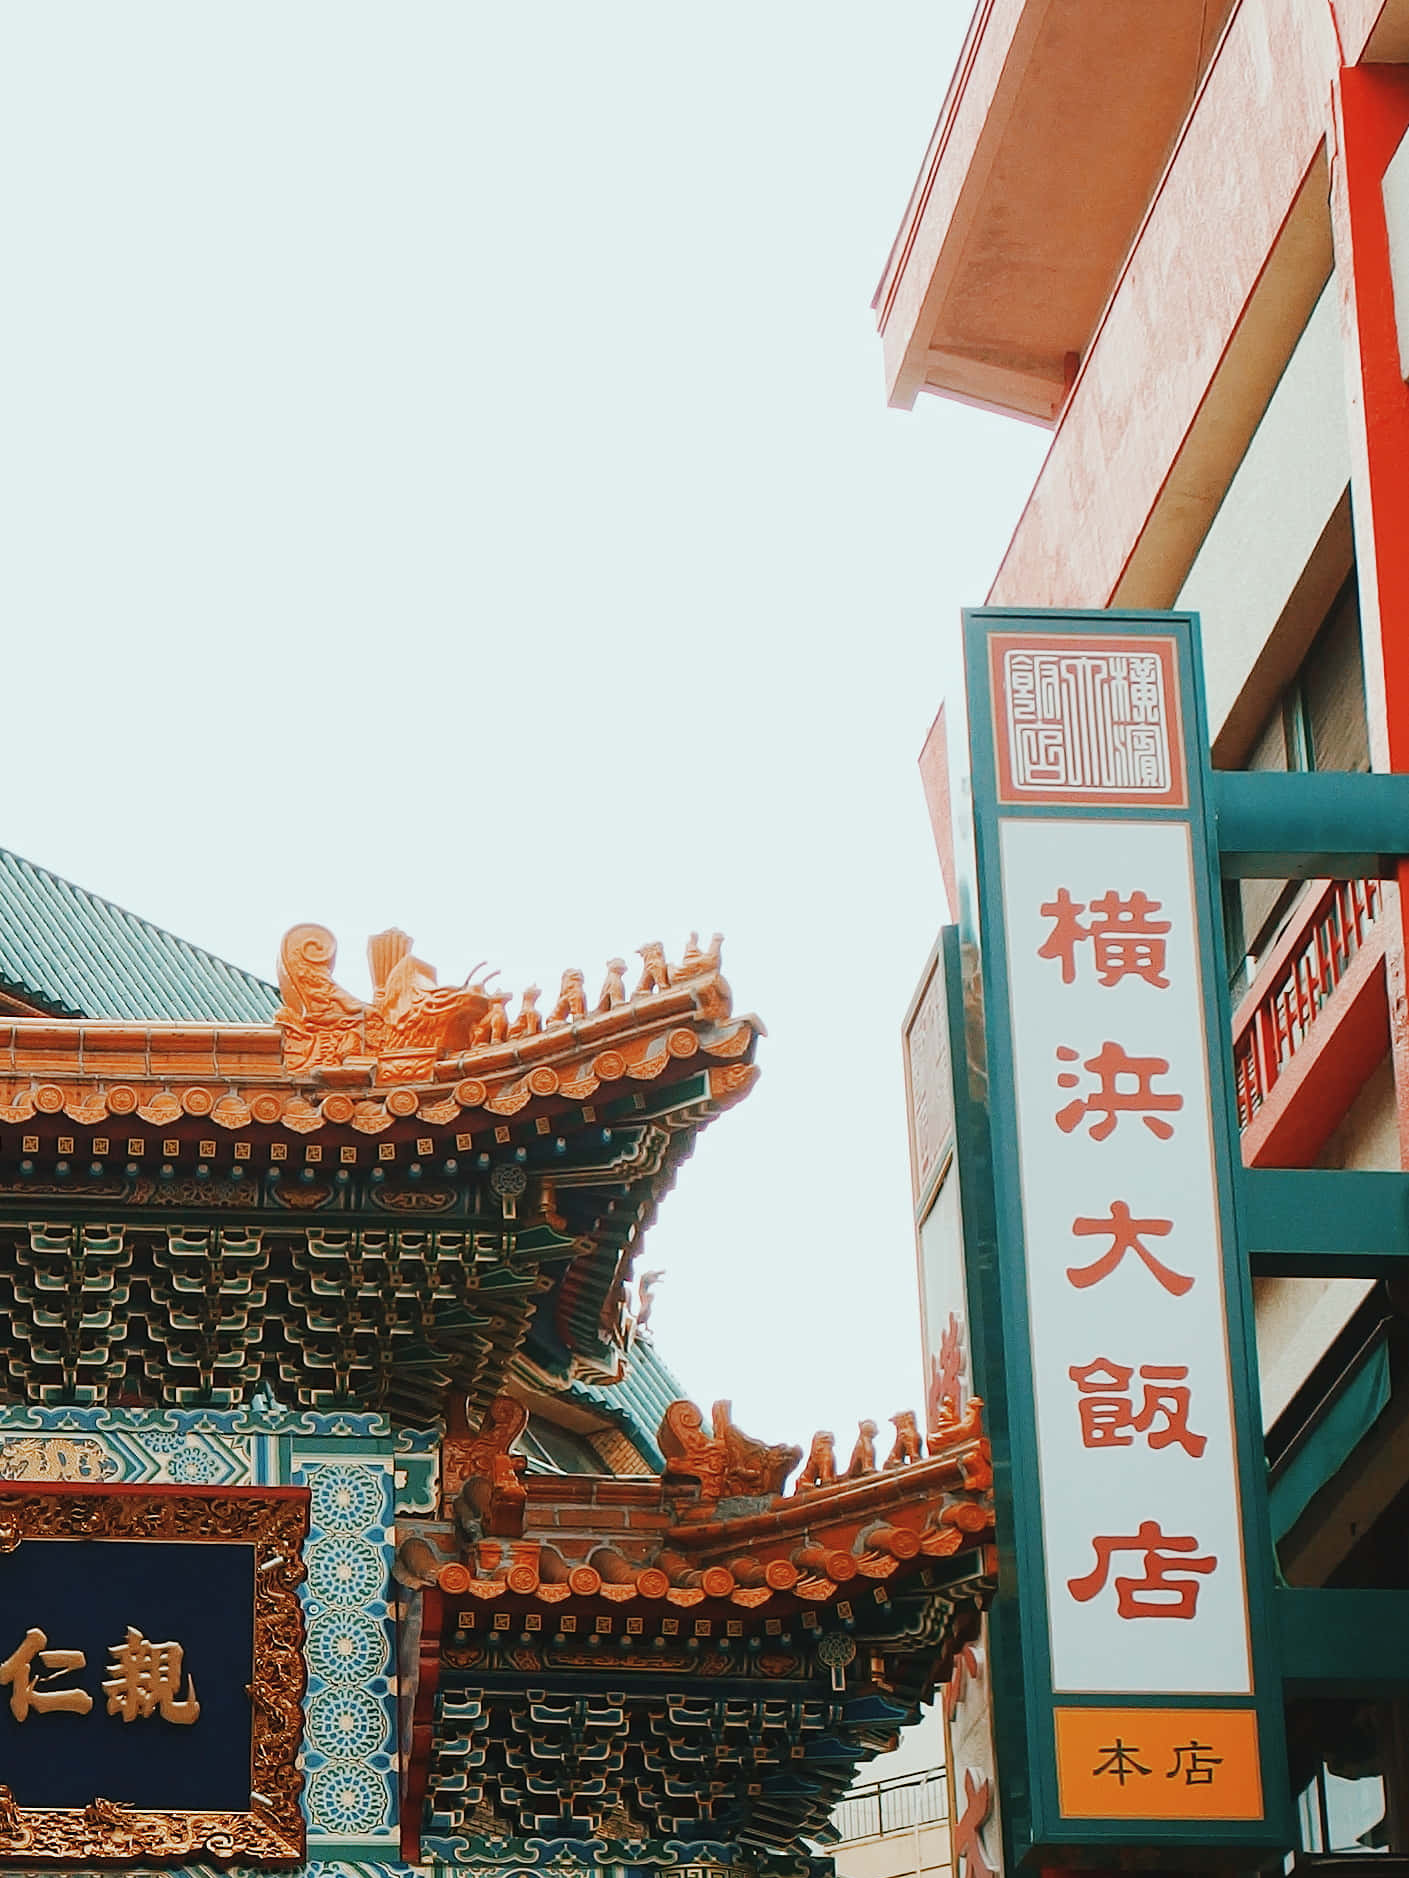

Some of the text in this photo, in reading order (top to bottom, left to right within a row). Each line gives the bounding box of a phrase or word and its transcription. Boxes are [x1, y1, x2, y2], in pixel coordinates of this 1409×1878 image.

[1038, 887, 1218, 1620] 横浜大飯店
[1093, 1738, 1223, 1786] 本店
